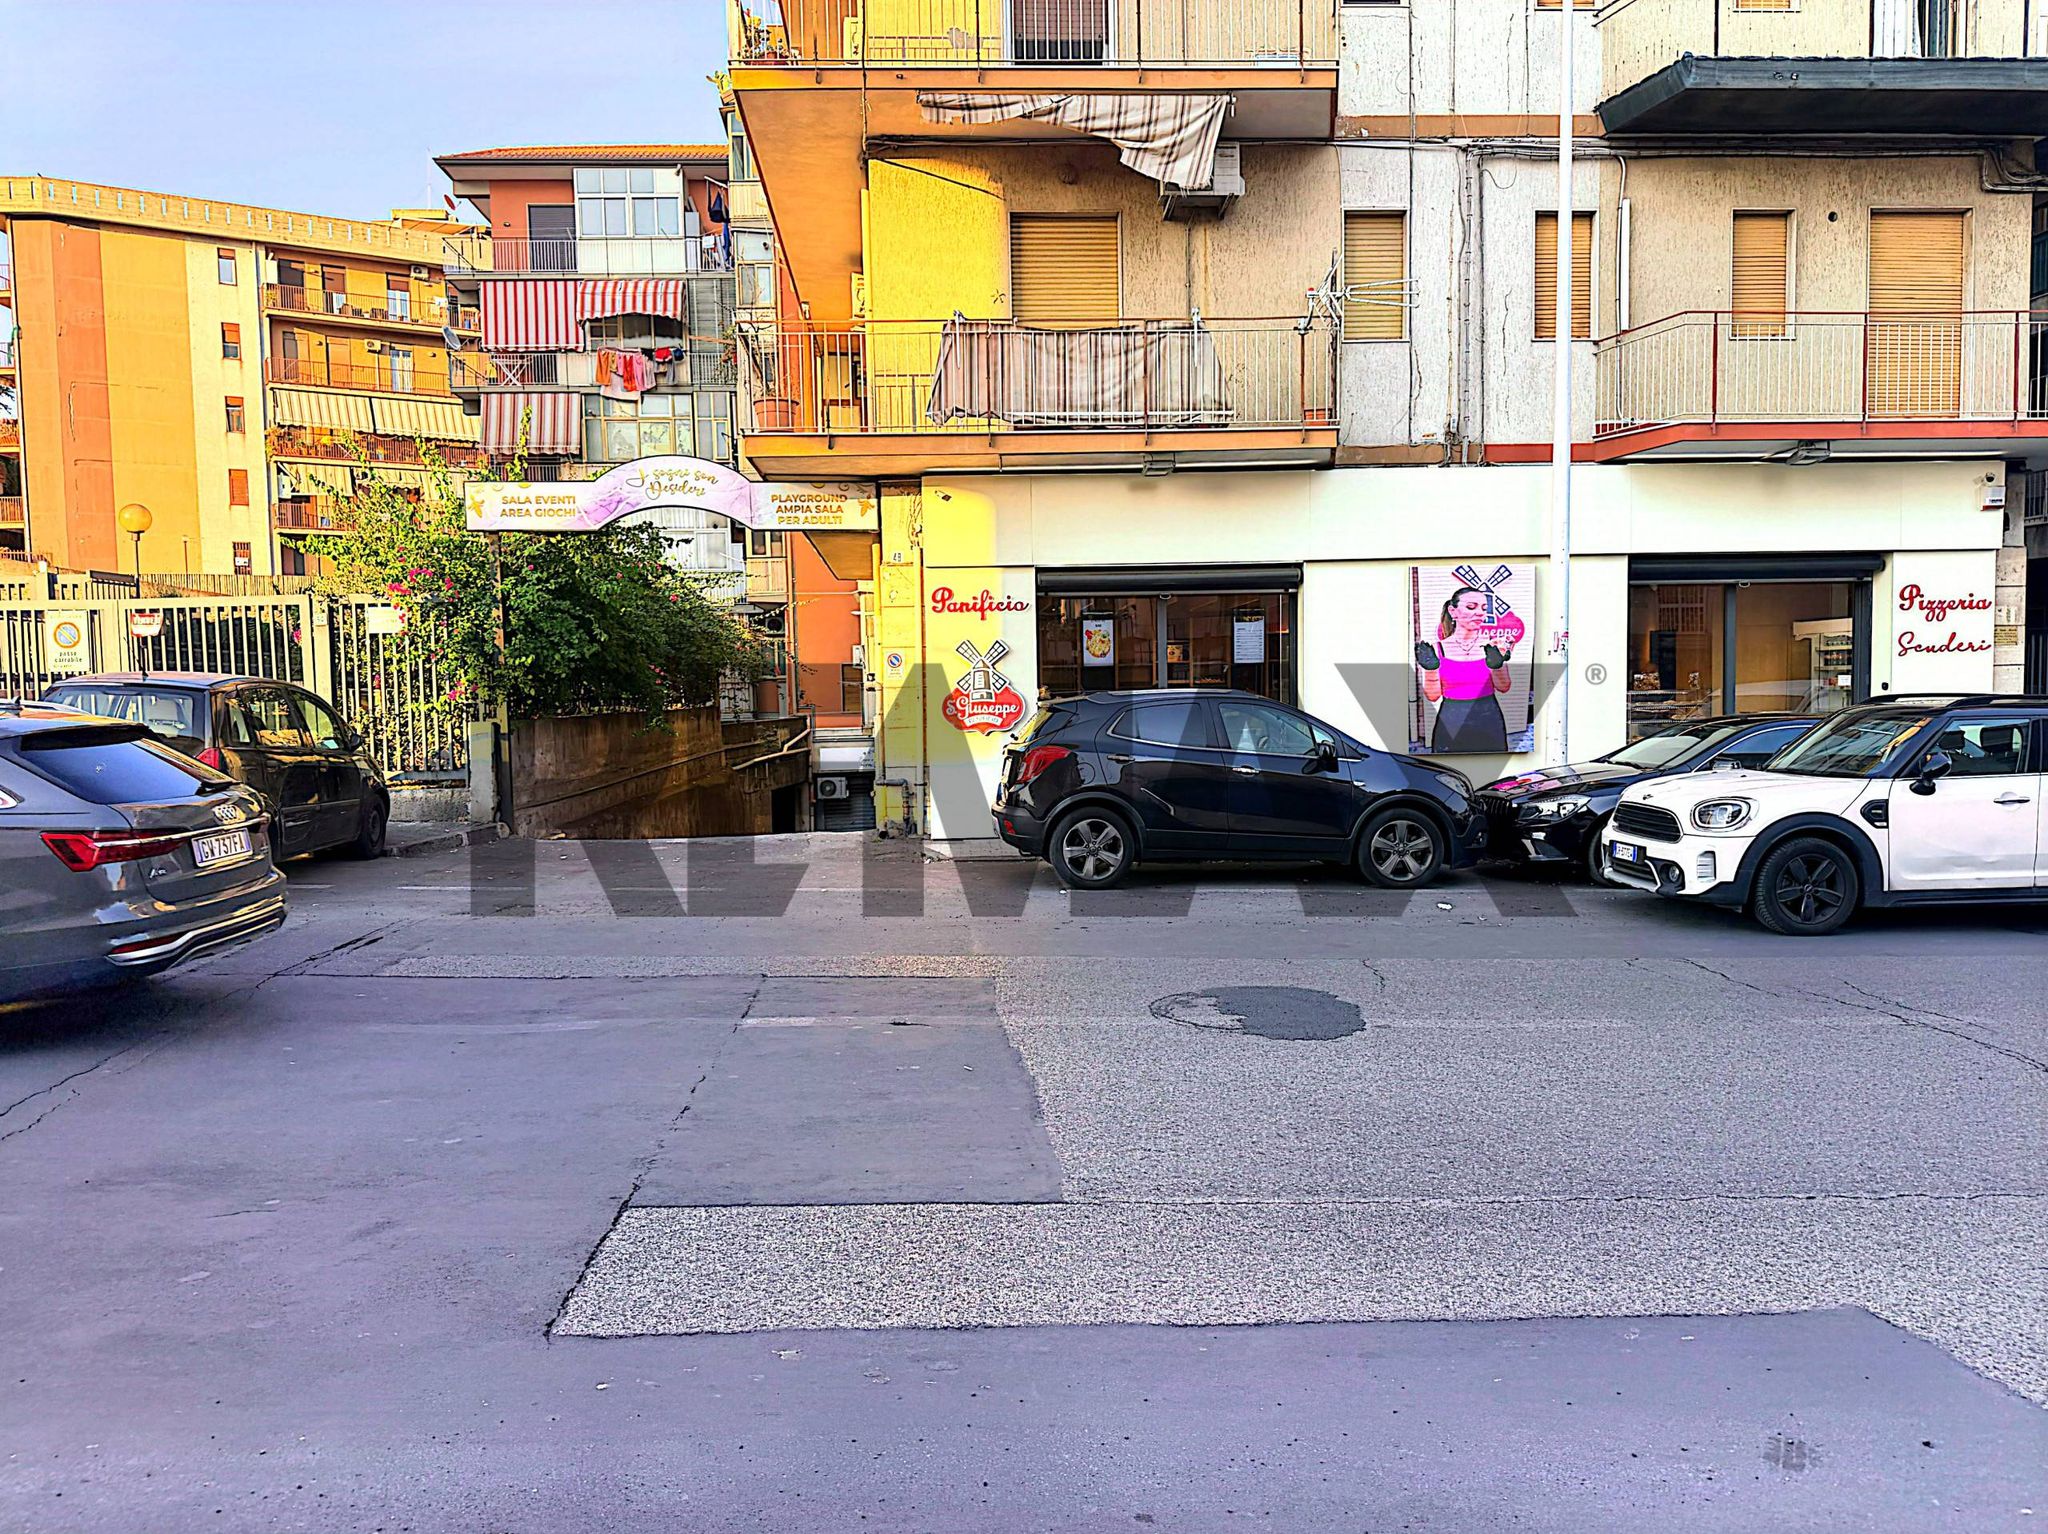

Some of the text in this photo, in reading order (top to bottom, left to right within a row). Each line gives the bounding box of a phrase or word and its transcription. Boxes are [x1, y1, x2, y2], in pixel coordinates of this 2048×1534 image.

[501, 495, 576, 505] SALA EVENTI
[771, 494, 848, 503] PLAYGROUND
[500, 508, 576, 518] AREA GIOCHI
[776, 505, 844, 514] AMPIA SALA
[778, 515, 842, 525] PER ADULTI
[931, 586, 1030, 621] Panificio
[1898, 583, 1993, 623] Pizzeria
[1897, 630, 1993, 658] Scuderi
[955, 695, 1019, 720] Giuseppe
